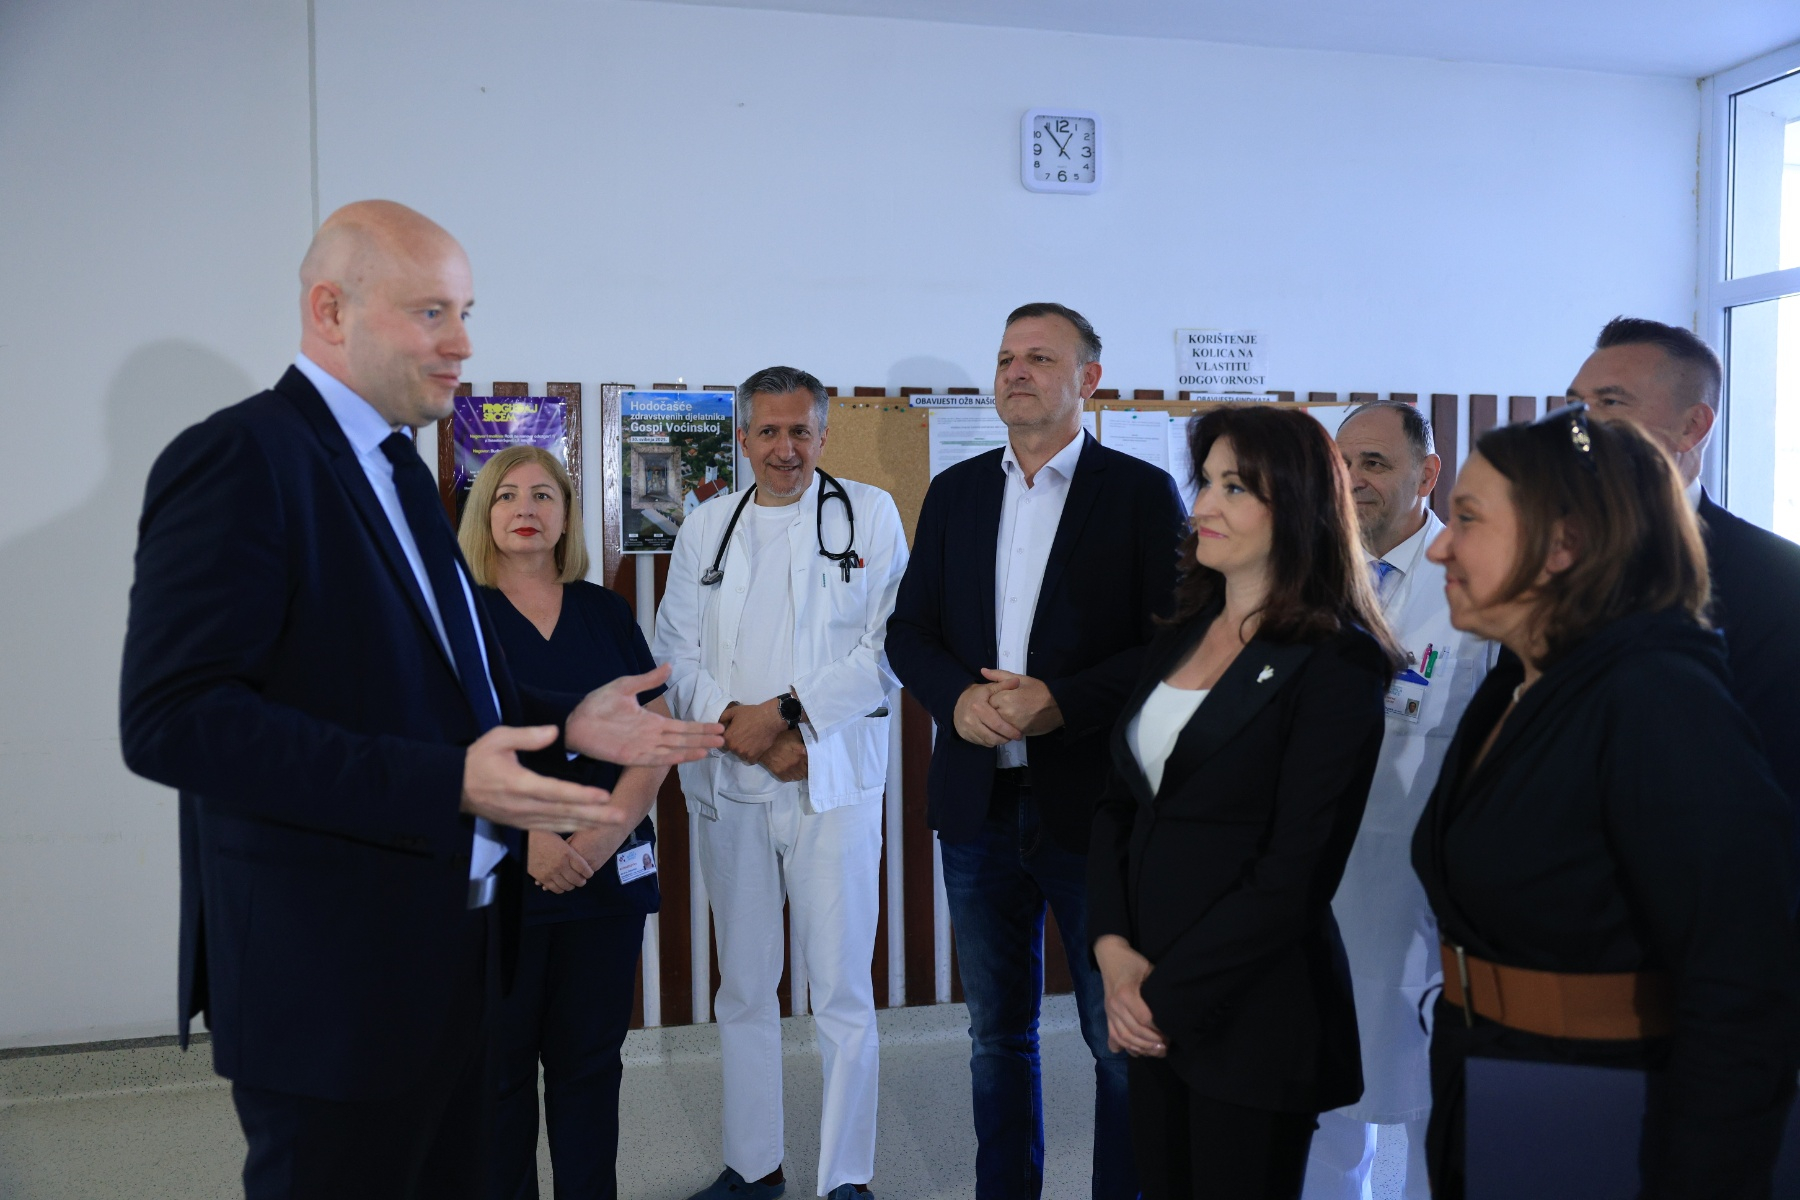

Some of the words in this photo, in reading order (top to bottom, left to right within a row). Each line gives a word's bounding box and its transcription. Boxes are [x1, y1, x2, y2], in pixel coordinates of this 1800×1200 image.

[1056, 120, 1069, 133] 12
[1033, 144, 1042, 155] 9
[1081, 146, 1092, 158] 3
[1057, 170, 1067, 182] 6
[1188, 333, 1257, 344] KORIŠTENJE
[1192, 348, 1235, 357] KOLICA
[1238, 348, 1253, 357] NA
[1195, 362, 1250, 371] VLASTITU
[1179, 375, 1265, 385] ODGOVORNOST
[630, 400, 693, 411] Hodočašće
[958, 396, 973, 405] OŽB
[630, 412, 683, 420] zdravstvenih
[685, 412, 725, 421] djelatnika
[630, 422, 663, 434] Gospi
[666, 422, 720, 434] Voćinskoj
